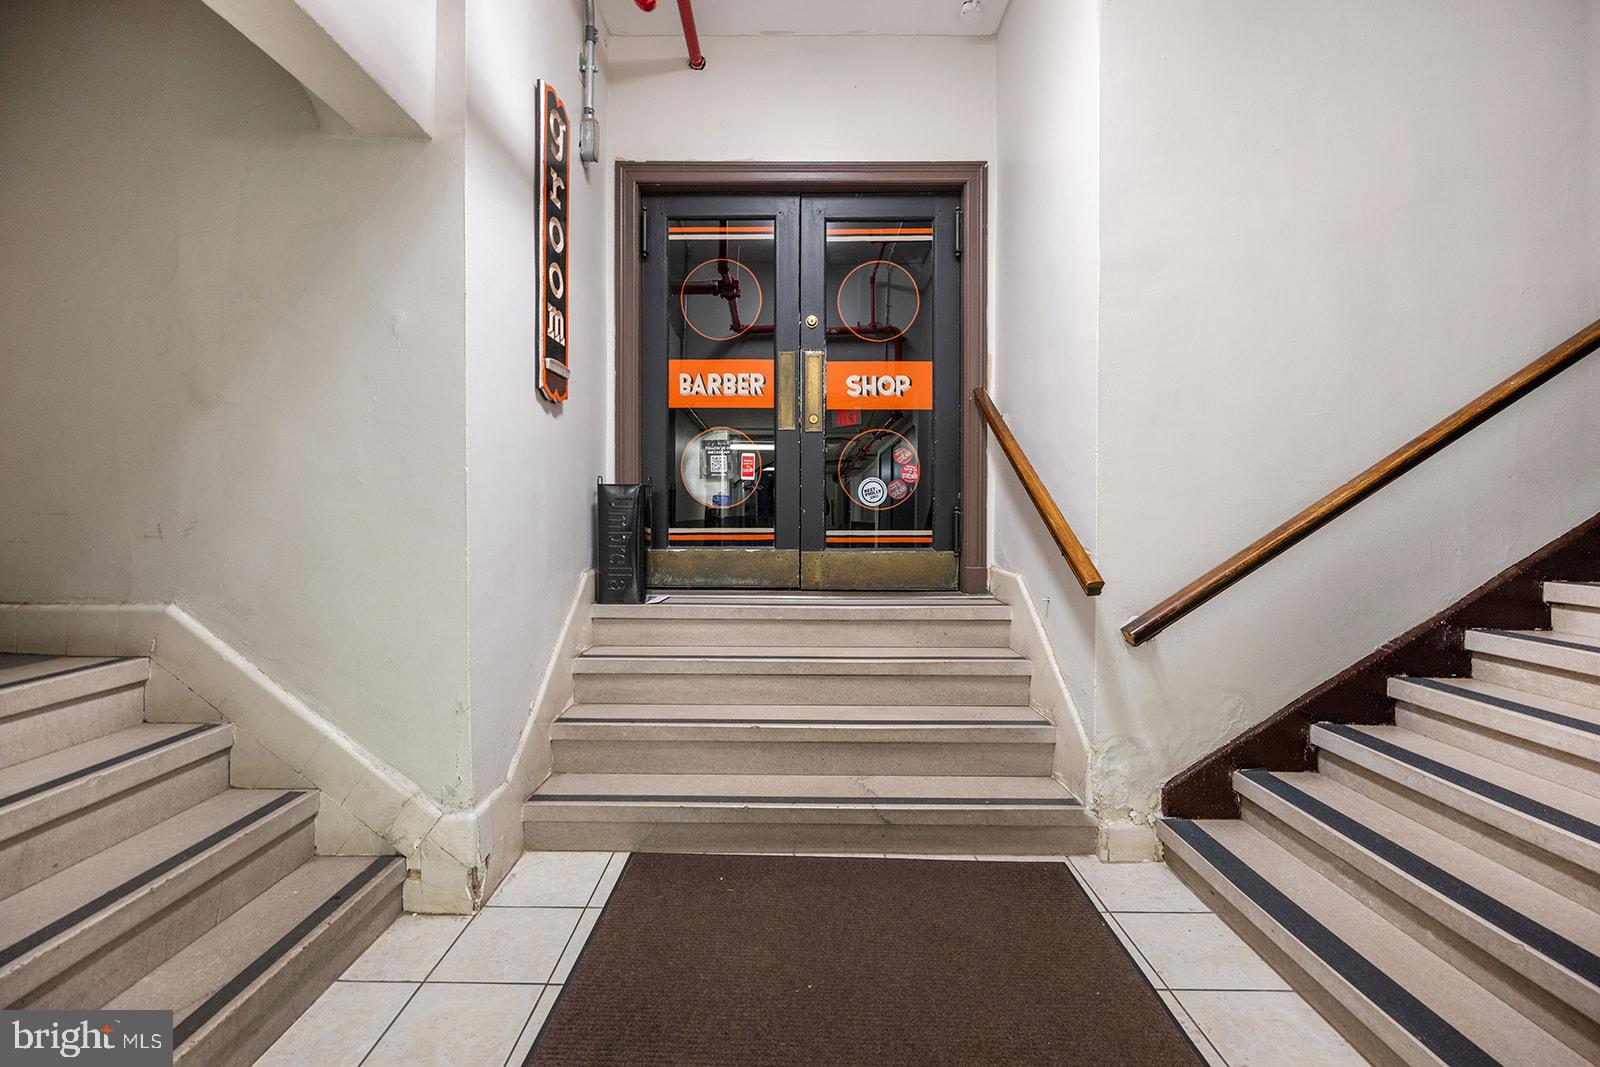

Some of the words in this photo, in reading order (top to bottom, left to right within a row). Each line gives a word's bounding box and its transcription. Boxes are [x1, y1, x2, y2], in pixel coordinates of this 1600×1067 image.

[547, 109, 566, 347] groom
[679, 373, 766, 397] BARBER
[845, 374, 912, 398] SHOP
